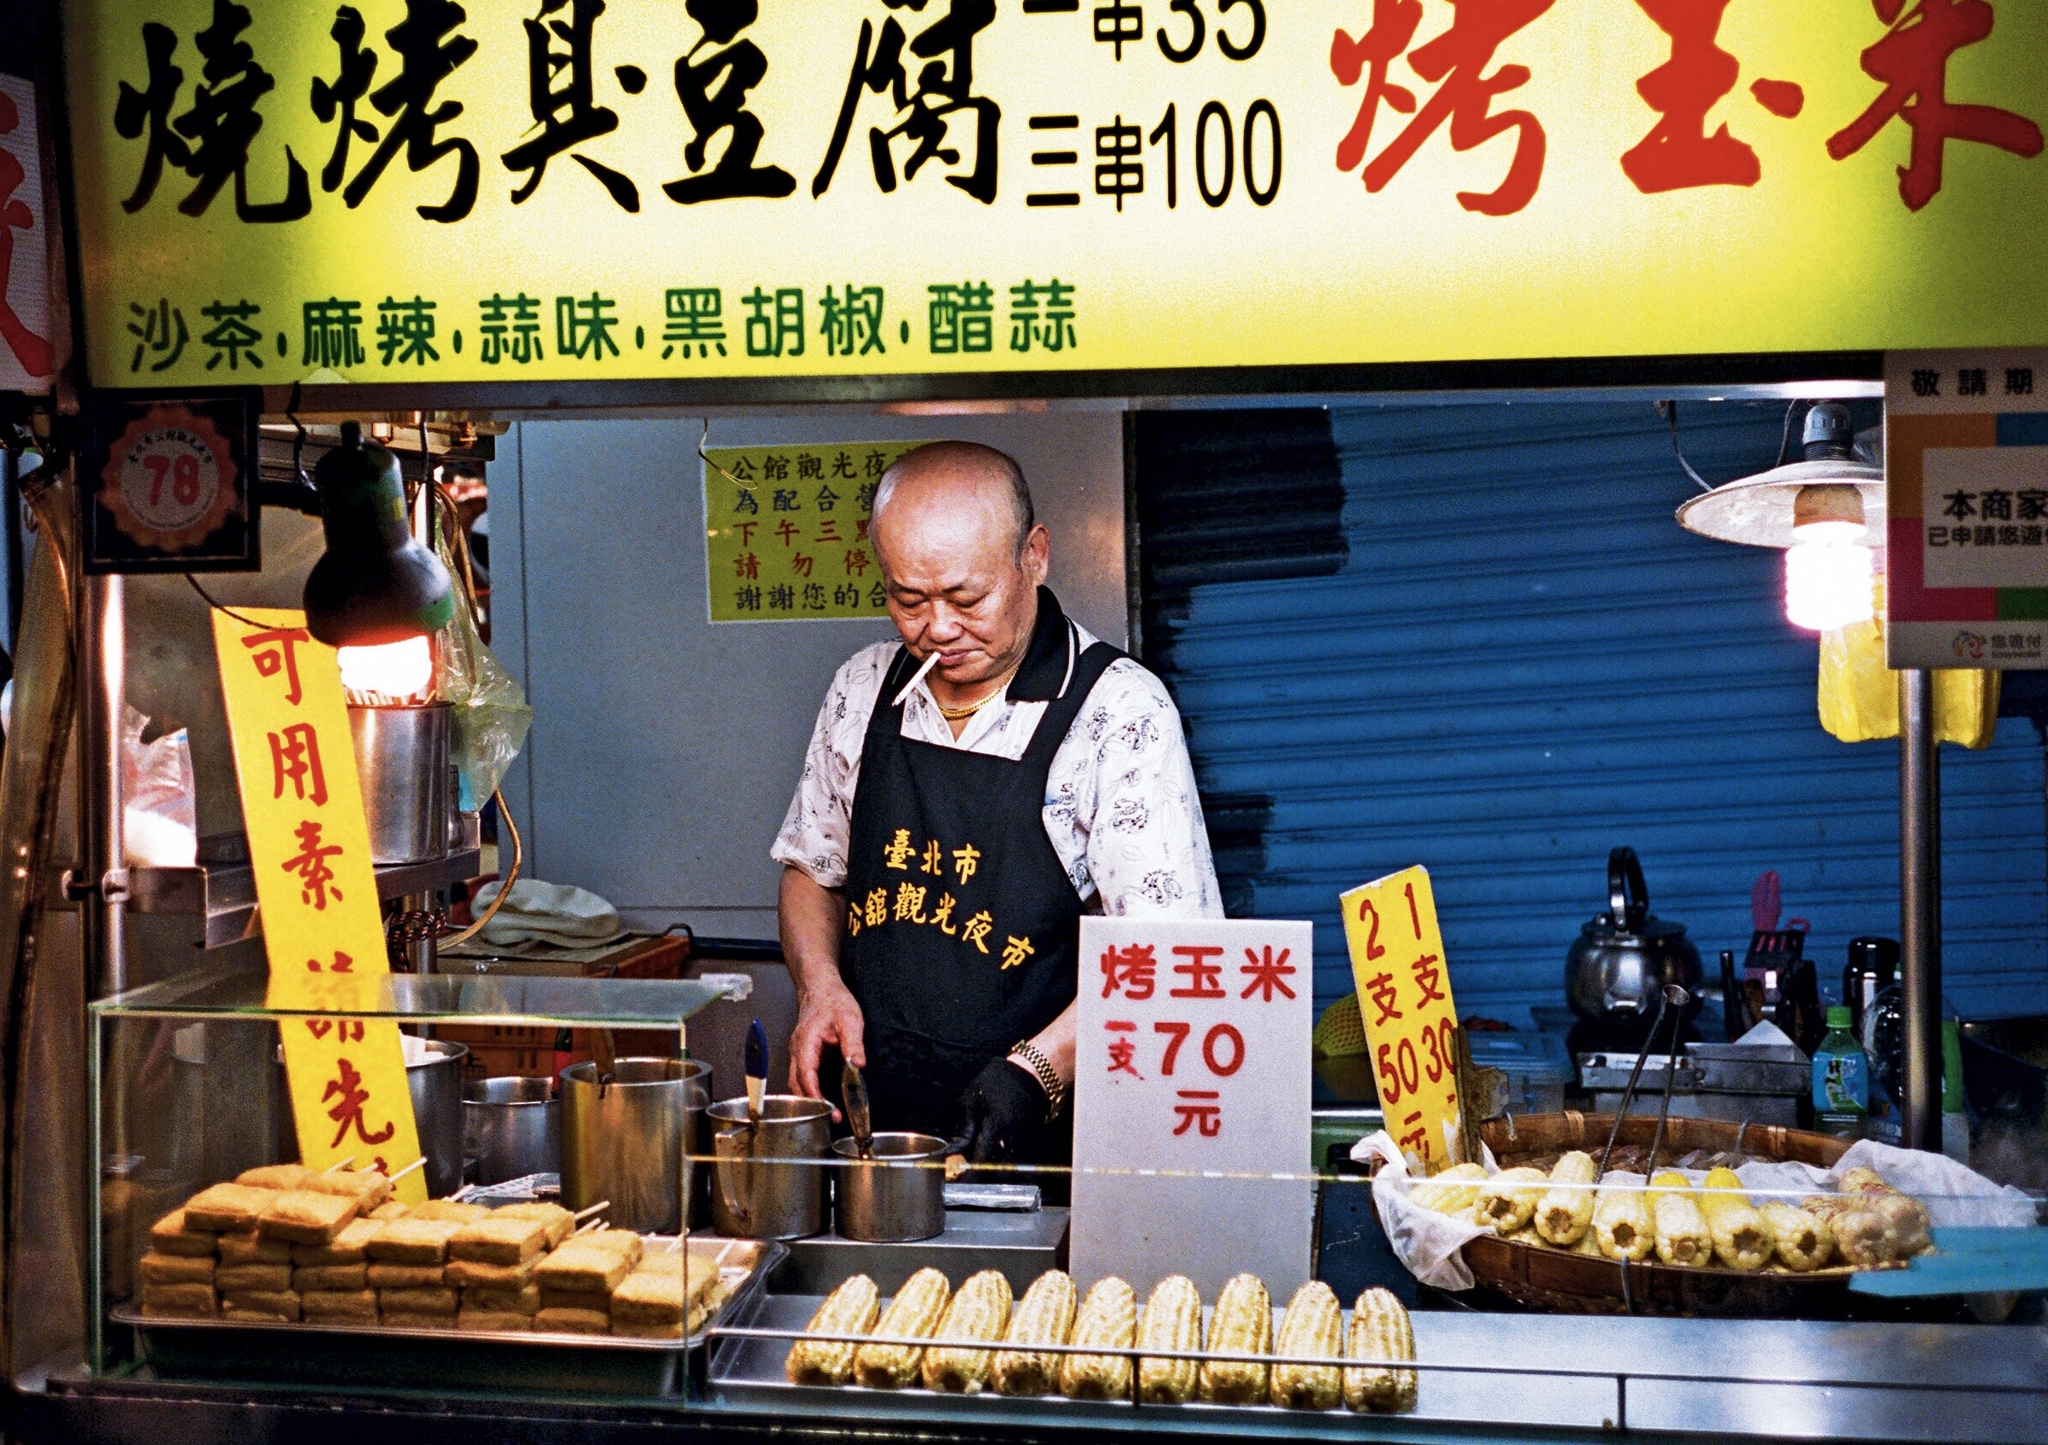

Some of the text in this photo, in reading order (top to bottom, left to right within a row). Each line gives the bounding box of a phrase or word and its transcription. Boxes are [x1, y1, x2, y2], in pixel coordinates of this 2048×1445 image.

[113, 0, 1002, 223] 燒烤臭豆腐
[1026, 98, 1283, 213] 三串100
[143, 455, 200, 507] 78
[1928, 525, 2048, 547] 已申請悠遊
[733, 548, 872, 581] 請勿停
[884, 828, 981, 885] 臺北市
[849, 882, 1035, 970] 公館觀光夜市
[1100, 943, 1297, 1003] 烤玉米
[1153, 1022, 1246, 1077] 70
[1172, 1090, 1222, 1137] 元
